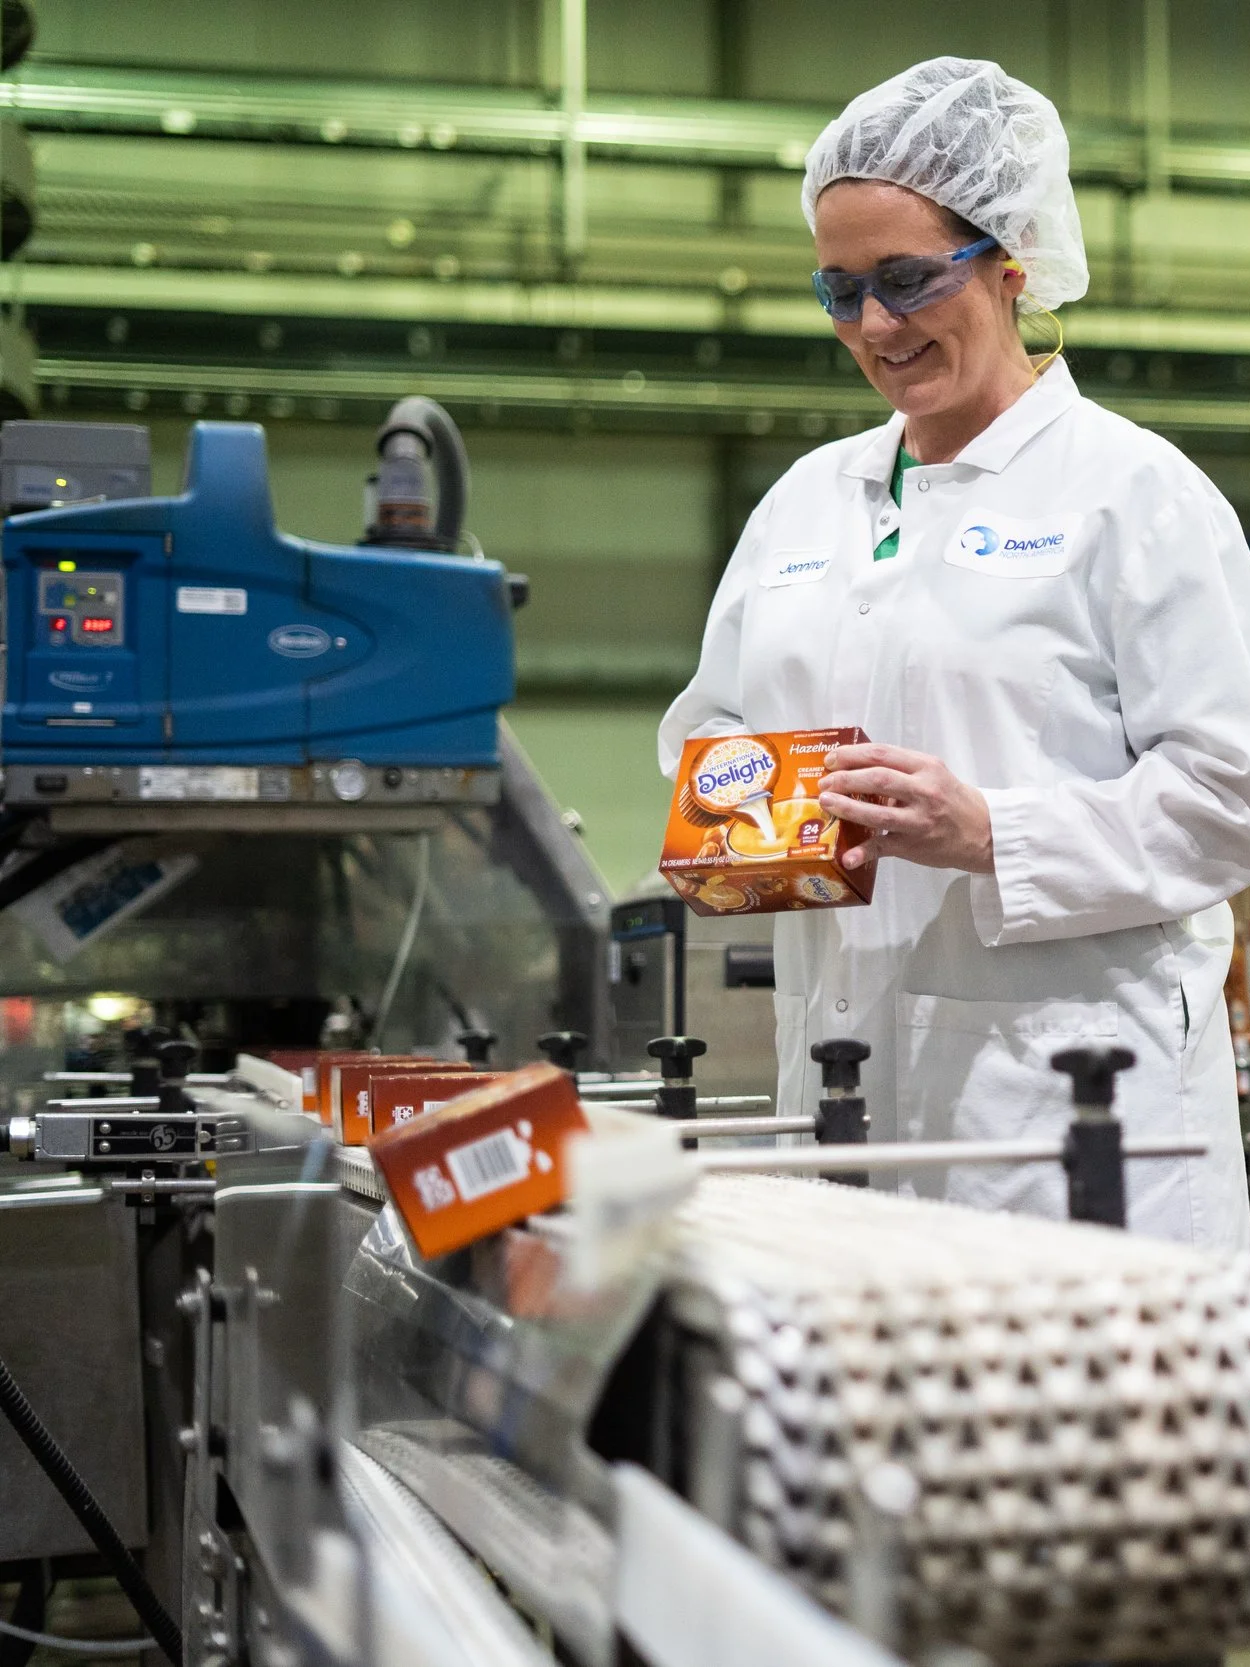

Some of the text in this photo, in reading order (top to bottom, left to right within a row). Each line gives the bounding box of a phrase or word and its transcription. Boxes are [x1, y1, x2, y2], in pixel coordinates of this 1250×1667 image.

[1004, 534, 1064, 551] DANONE
[999, 546, 1065, 559] NORTH AMERICA
[779, 559, 829, 575] Jennifer
[789, 741, 840, 755] Hazelnut
[709, 751, 758, 772] INTERNATIONAL
[698, 753, 773, 794] Delight
[803, 823, 819, 835] 24
[668, 858, 691, 867] CREAMERS
